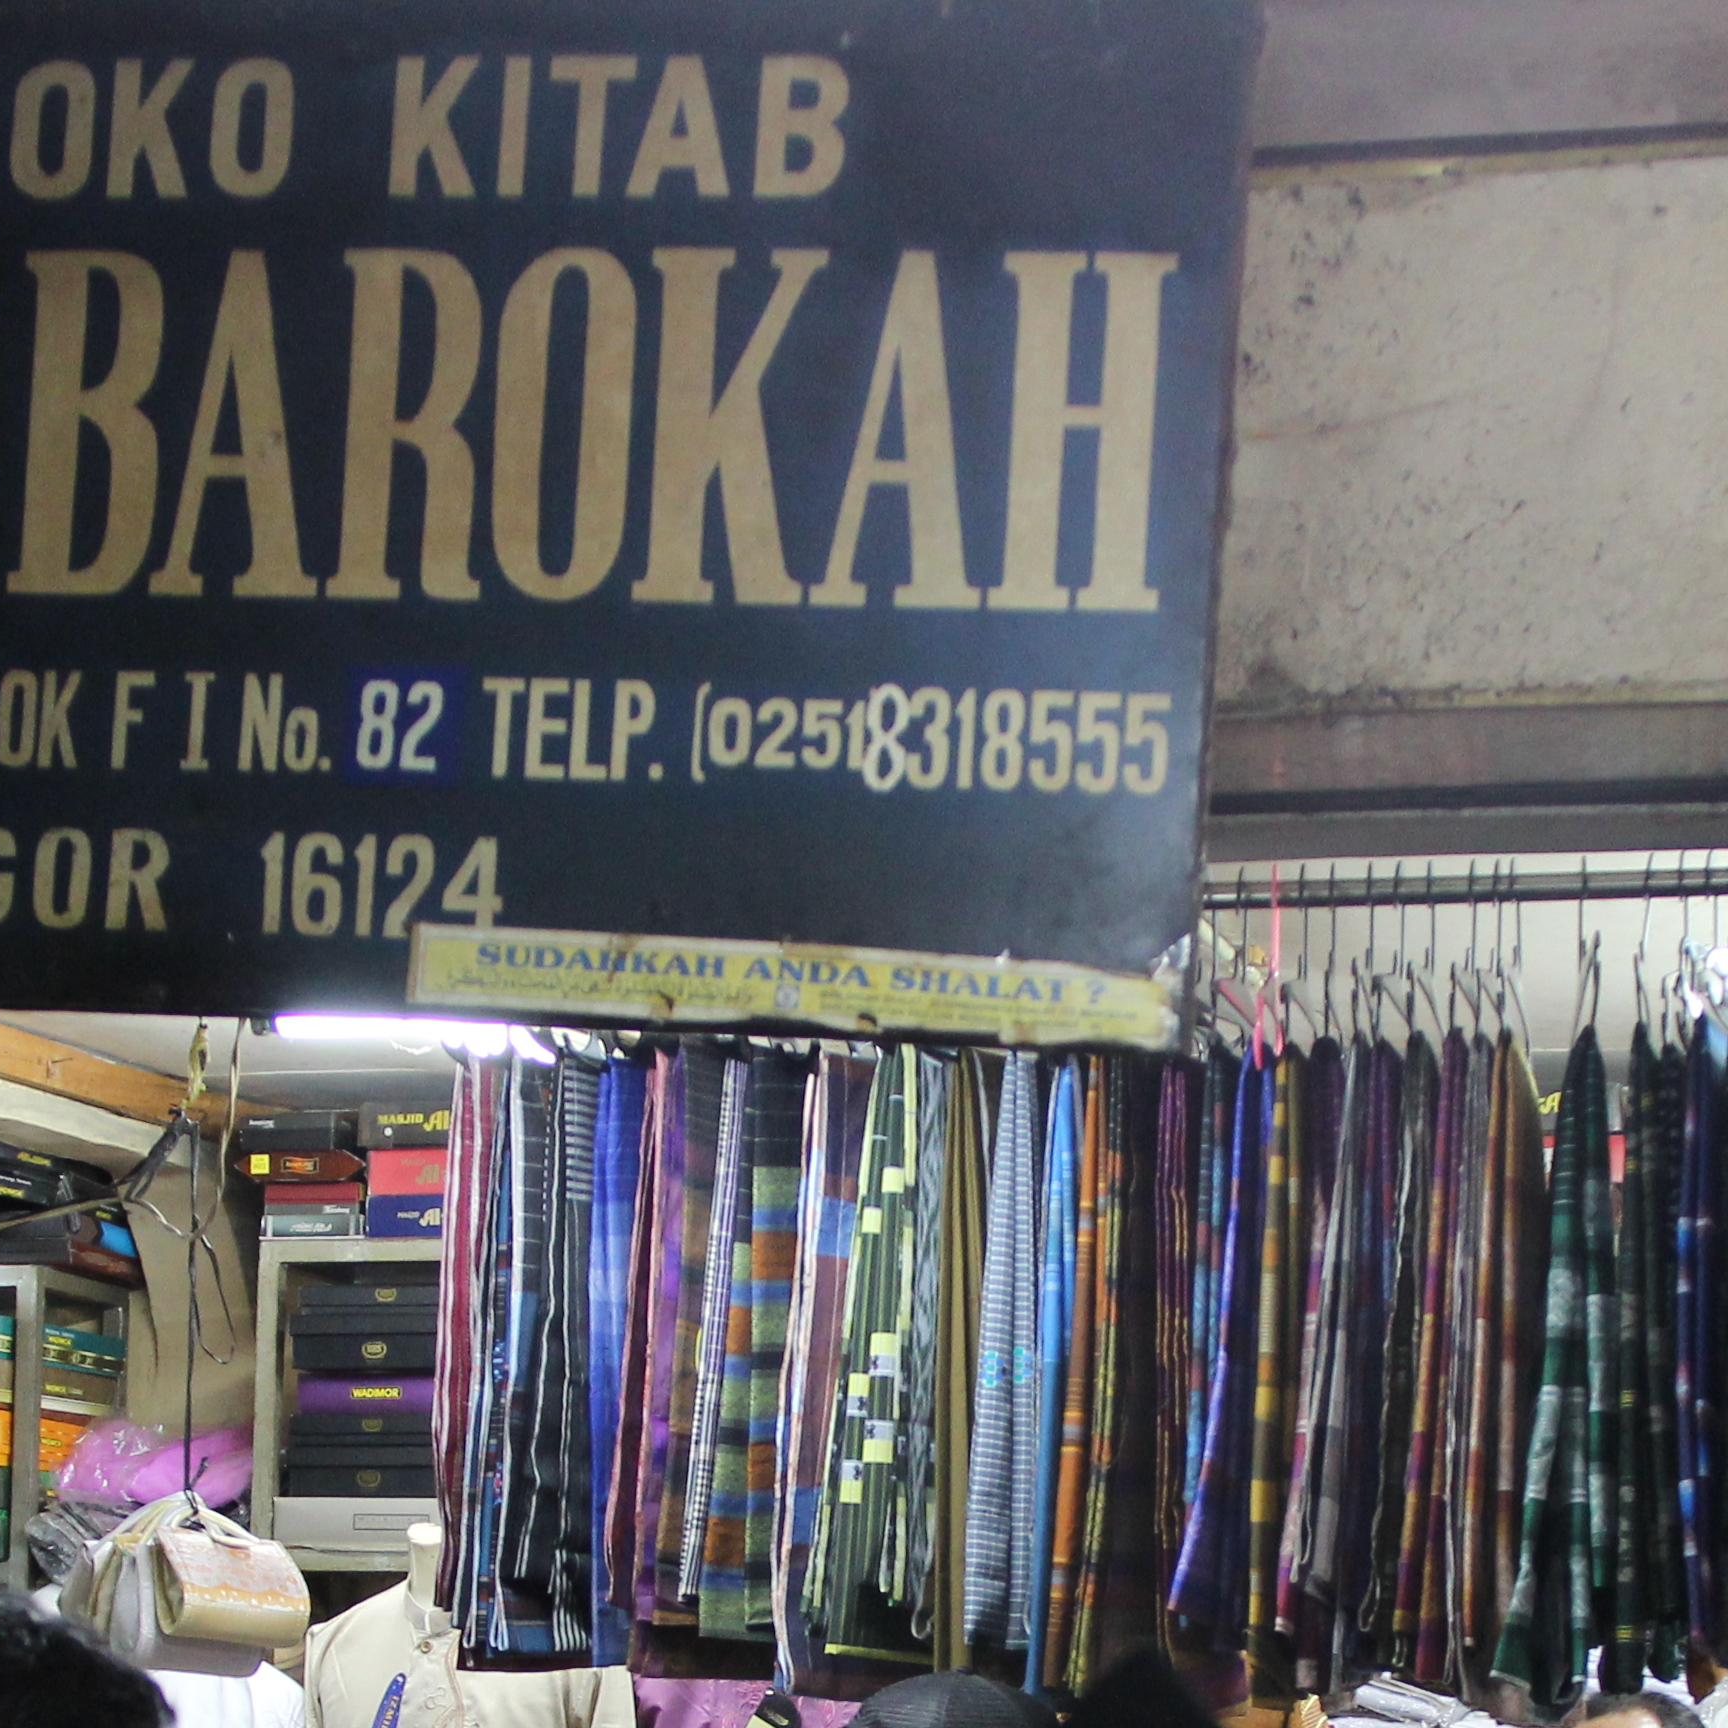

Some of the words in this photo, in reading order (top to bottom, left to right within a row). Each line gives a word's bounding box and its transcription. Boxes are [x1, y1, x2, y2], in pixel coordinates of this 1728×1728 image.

[389, 54, 851, 199] KITAB
[7, 247, 1179, 615] BAROKAH
[111, 671, 156, 769] F
[180, 672, 215, 771] I
[238, 673, 332, 773] No.
[355, 679, 445, 773] 82
[483, 677, 664, 782] TELP.
[261, 831, 504, 940] 16124
[744, 955, 869, 990] ANDA
[890, 963, 1075, 1001] SHALAT
[376, 1113, 424, 1125] MASJID
[351, 1387, 400, 1399] WADIMOR
